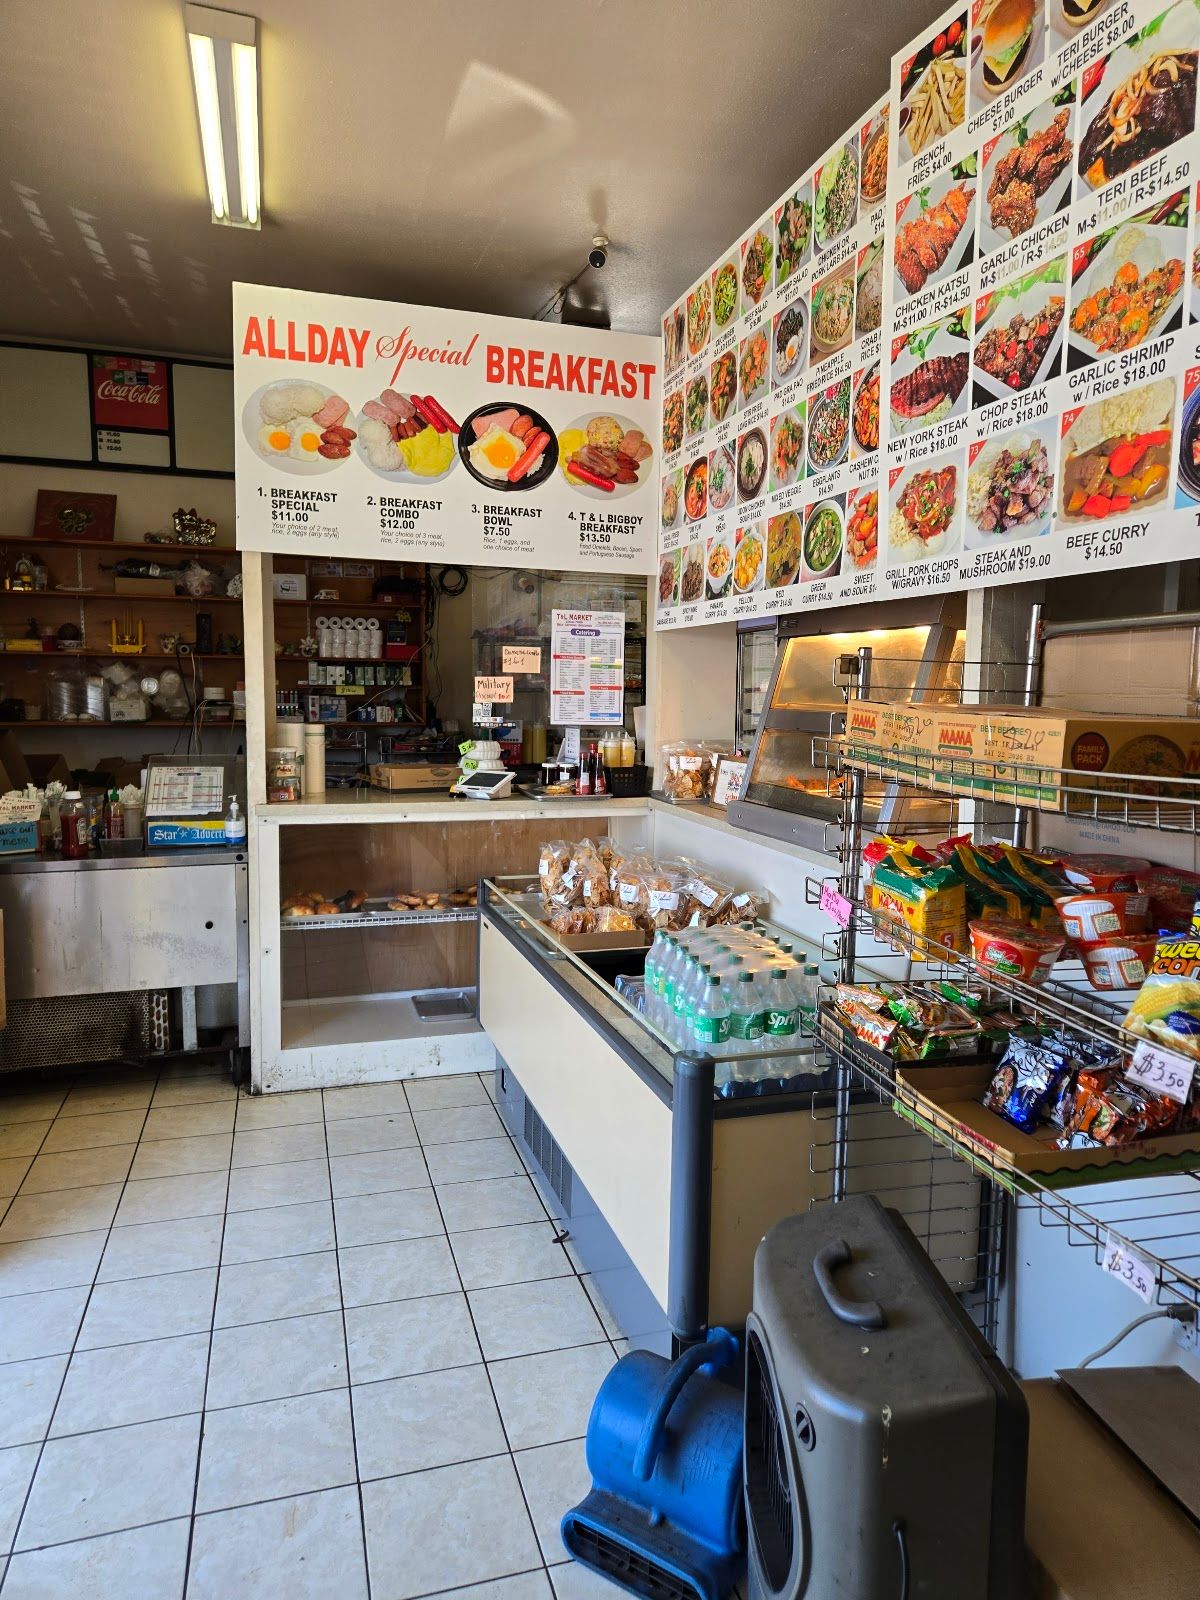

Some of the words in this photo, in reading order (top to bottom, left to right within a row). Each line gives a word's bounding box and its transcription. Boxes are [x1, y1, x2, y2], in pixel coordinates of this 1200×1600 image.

[1058, 40, 1080, 67] TERI
[1082, 2, 1128, 48] BURGER
[1107, 15, 1134, 46] $8.00
[1084, 68, 1095, 84] 57
[968, 100, 1002, 134] CHEESE
[1004, 70, 1042, 108] BURGER
[993, 106, 1014, 132] $7.00
[913, 141, 945, 172] FRENCH
[983, 145, 994, 159] 56
[908, 166, 930, 190] FRIES
[932, 152, 951, 174] $4.00
[1097, 179, 1126, 207] TERI
[1130, 155, 1167, 188] BEEF
[1135, 161, 1189, 203] R-$14.50
[896, 201, 907, 214] 55
[871, 209, 882, 224] PAD
[818, 246, 840, 266] CHICKEN
[842, 236, 849, 249] OR
[980, 244, 1018, 274] GARLIC
[1021, 213, 1070, 252] CHICKEN
[1074, 247, 1085, 260] 65
[793, 269, 808, 287] SALAD
[812, 265, 825, 282] PORK
[896, 289, 935, 318] CHICKEN
[938, 272, 969, 298] KATSU
[755, 300, 768, 317] SALAD
[894, 308, 927, 332] M-$11.00
[935, 286, 970, 313] R-$14.50
[976, 299, 986, 312] 64
[861, 333, 877, 350] CRAB
[242, 316, 371, 368] ALLDAY
[375, 326, 480, 386] Special
[486, 344, 656, 400] BREAKFAST
[860, 346, 874, 362] RICE
[816, 352, 845, 376] PINEAPPLE
[1069, 360, 1116, 388] GARLIC
[1120, 337, 1174, 370] SHRIMP
[1093, 378, 1119, 396] Rice
[1124, 358, 1166, 386] $18.00
[980, 402, 1008, 422] CHOP
[1011, 386, 1047, 410] STEAK
[992, 418, 1013, 432] Rice
[1016, 402, 1048, 424] $18.00
[1064, 414, 1075, 425] 74
[888, 438, 907, 453] NEW
[910, 428, 934, 446] YORK
[937, 416, 968, 437] STEAK
[910, 447, 927, 459] Rice
[930, 434, 958, 453] $18.00
[970, 445, 980, 456] 73
[850, 456, 874, 473] CASHEW
[858, 469, 871, 481] NUT
[258, 487, 267, 497] 1.
[271, 488, 337, 503] BREAKFAST
[271, 500, 319, 512] SPECIAL
[367, 496, 376, 506] 2.
[380, 497, 442, 511] BREAKFAST
[472, 504, 480, 514] 3.
[483, 505, 542, 518] BREAKFAST
[271, 511, 308, 522] $11.00
[380, 508, 419, 519] COMBO
[484, 516, 512, 526] BOWL
[568, 512, 576, 521] 4.
[580, 512, 586, 521] T
[589, 514, 596, 522] &
[599, 514, 604, 522] L
[608, 514, 643, 525] BIGBOY
[380, 519, 414, 529] $12.00
[483, 526, 510, 537] $7.50
[580, 523, 636, 534] BREAKFAST
[580, 533, 610, 543] $13.50
[1067, 532, 1099, 549] BEEF
[1102, 522, 1150, 542] CURRY
[975, 549, 1008, 566] STEAK
[1009, 545, 1031, 558] AND
[1085, 542, 1122, 560] $14.50
[886, 570, 907, 581] GRILL
[909, 564, 930, 577] PORK
[932, 559, 959, 572] CHOPS
[960, 560, 1016, 580] MUSHROOM
[1019, 554, 1051, 571] $19.00
[811, 582, 826, 592] GREEN
[854, 573, 874, 585] SWEET
[927, 573, 950, 586] $16.50
[840, 589, 851, 598] AND
[852, 586, 868, 597] SOUR
[478, 678, 511, 693] Military
[851, 714, 876, 729] MAMA
[980, 725, 996, 733] BEST
[939, 729, 972, 746] MAMA
[1077, 744, 1105, 754] FAMILY
[1077, 754, 1102, 763] PACK
[154, 829, 178, 841] Star
[1079, 830, 1095, 840] MADE
[1102, 835, 1120, 844] CHINA
